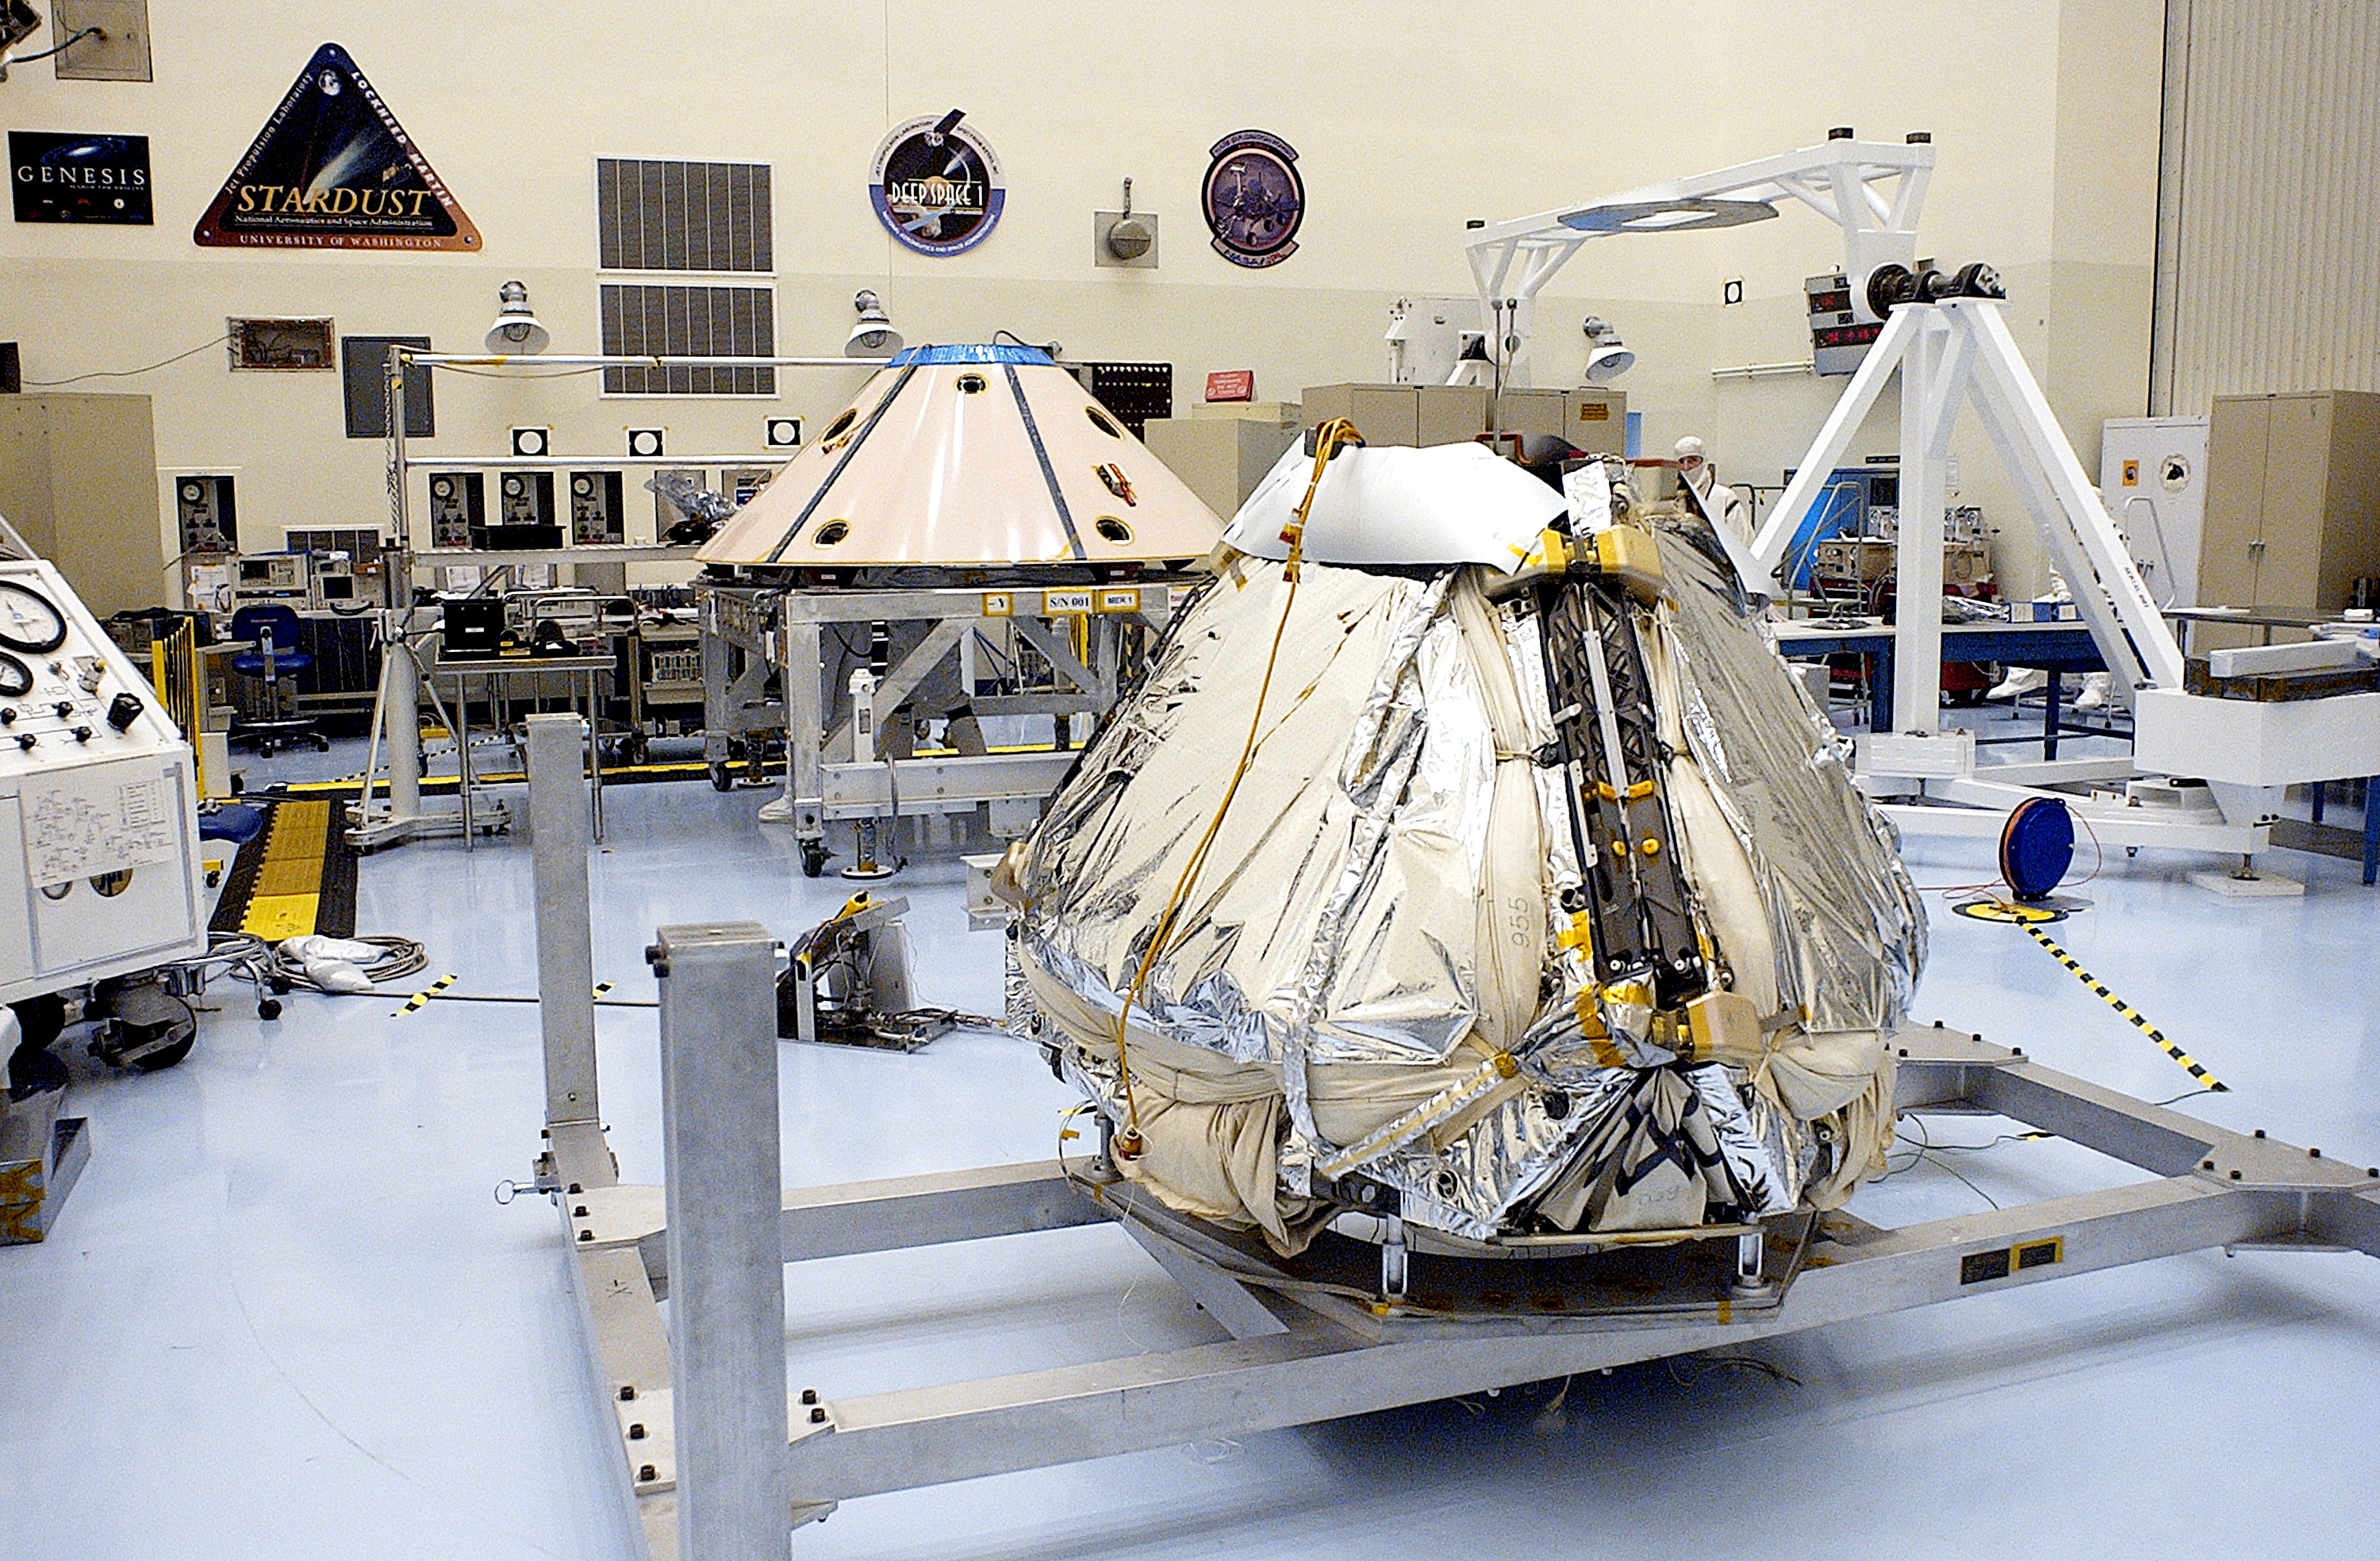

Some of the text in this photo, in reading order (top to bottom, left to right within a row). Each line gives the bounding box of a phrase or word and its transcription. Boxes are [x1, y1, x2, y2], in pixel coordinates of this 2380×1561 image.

[351, 71, 453, 207] LOCKHEED MARTIN
[17, 165, 145, 186] GENESIS
[237, 184, 432, 216] STARDUST
[892, 182, 983, 206] DEEP SPACE 1
[235, 214, 273, 224] National
[274, 216, 325, 224] Aeronautics
[344, 217, 368, 227] Space
[370, 218, 433, 227] Administration
[240, 235, 443, 247] UNIVERSITY OF WASHINGTON
[1050, 596, 1088, 608] S/N 001
[1507, 896, 1530, 949] 955
